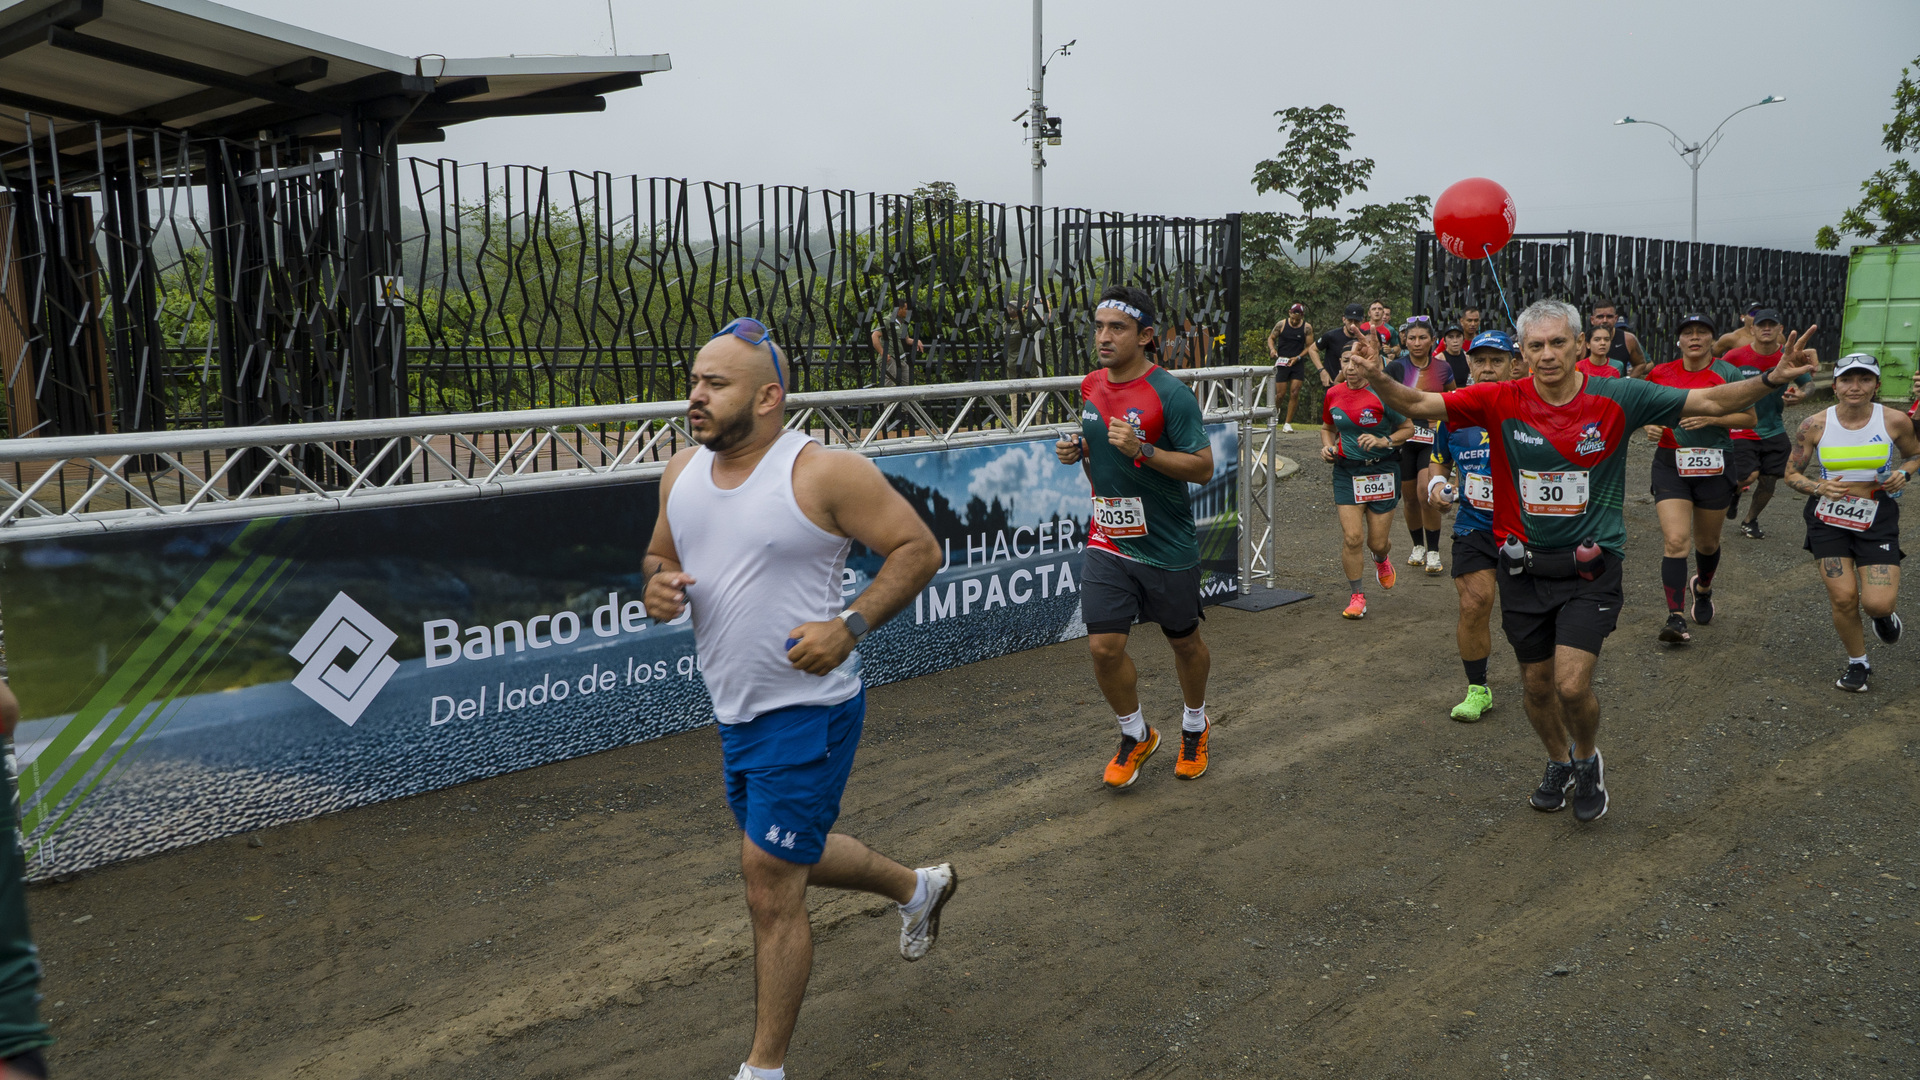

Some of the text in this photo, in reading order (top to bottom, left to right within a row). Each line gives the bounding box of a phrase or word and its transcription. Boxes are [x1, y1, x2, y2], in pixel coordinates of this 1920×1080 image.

[1687, 456, 1712, 467] 253
[1364, 482, 1385, 494] 694
[1481, 486, 1493, 500] 3
[1539, 485, 1564, 502] 30
[1100, 508, 1135, 525] 2035
[1826, 502, 1865, 520] 1644
[966, 518, 1084, 569] HACER,
[423, 610, 581, 669] Banco
[592, 591, 647, 638] de
[430, 685, 486, 727] Del
[498, 673, 570, 713] lado
[578, 663, 617, 695] de
[626, 656, 668, 686] los
